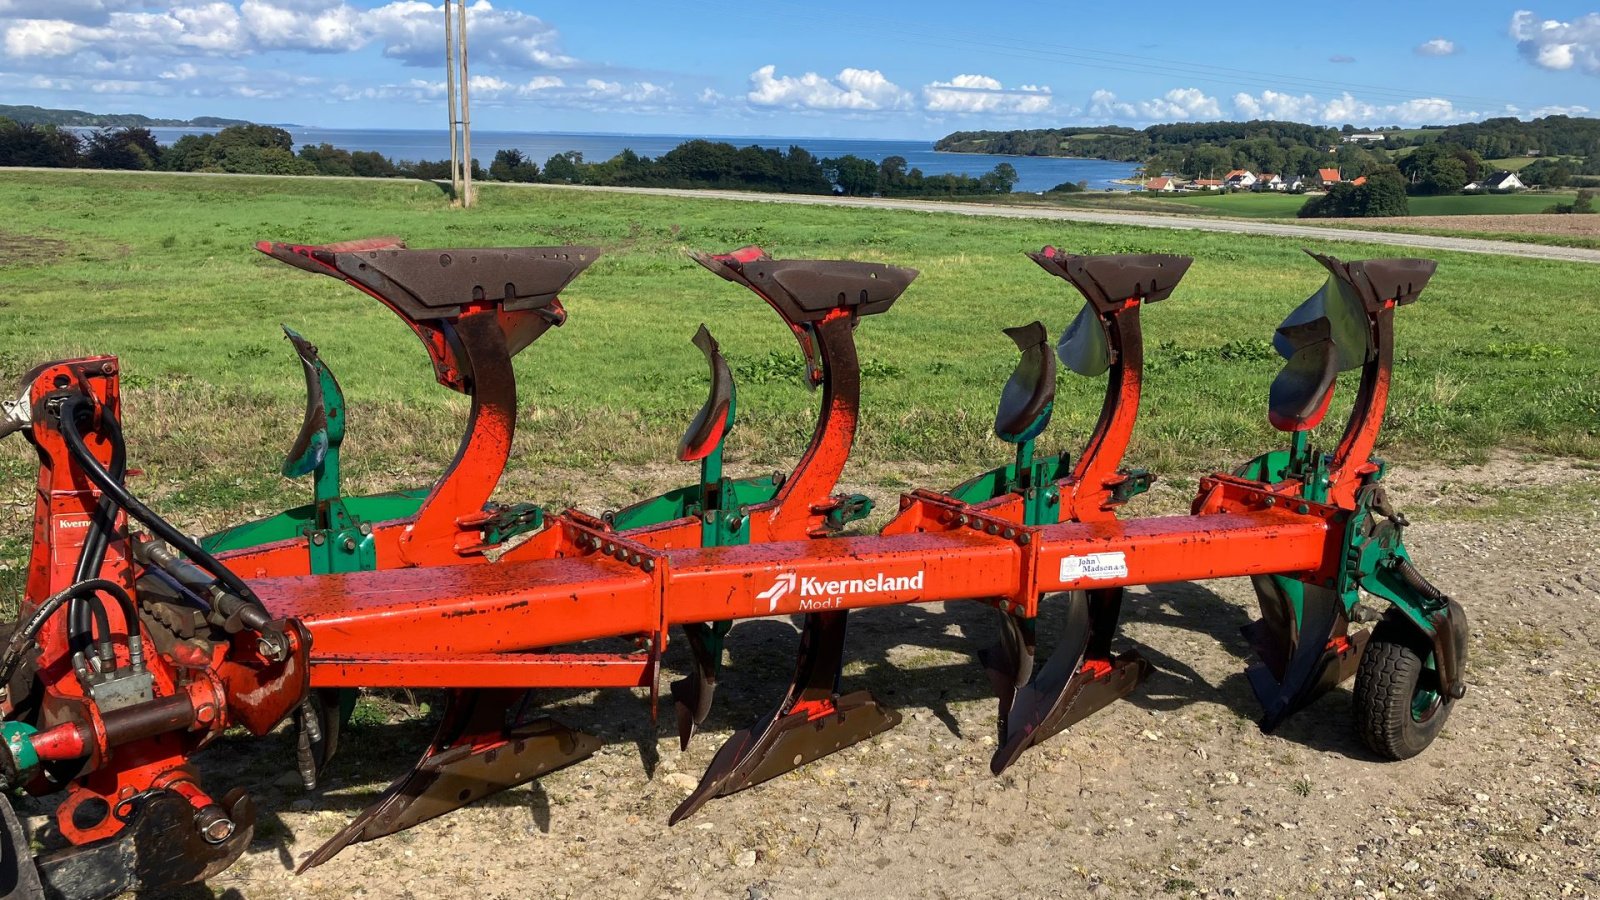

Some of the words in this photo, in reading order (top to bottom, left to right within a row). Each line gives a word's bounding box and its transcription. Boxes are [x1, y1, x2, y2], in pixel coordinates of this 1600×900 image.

[1078, 558, 1096, 567] John
[1082, 564, 1113, 573] Madsen
[800, 570, 924, 597] Kverneland
[799, 597, 833, 611] Mod.
[835, 596, 843, 608] F
